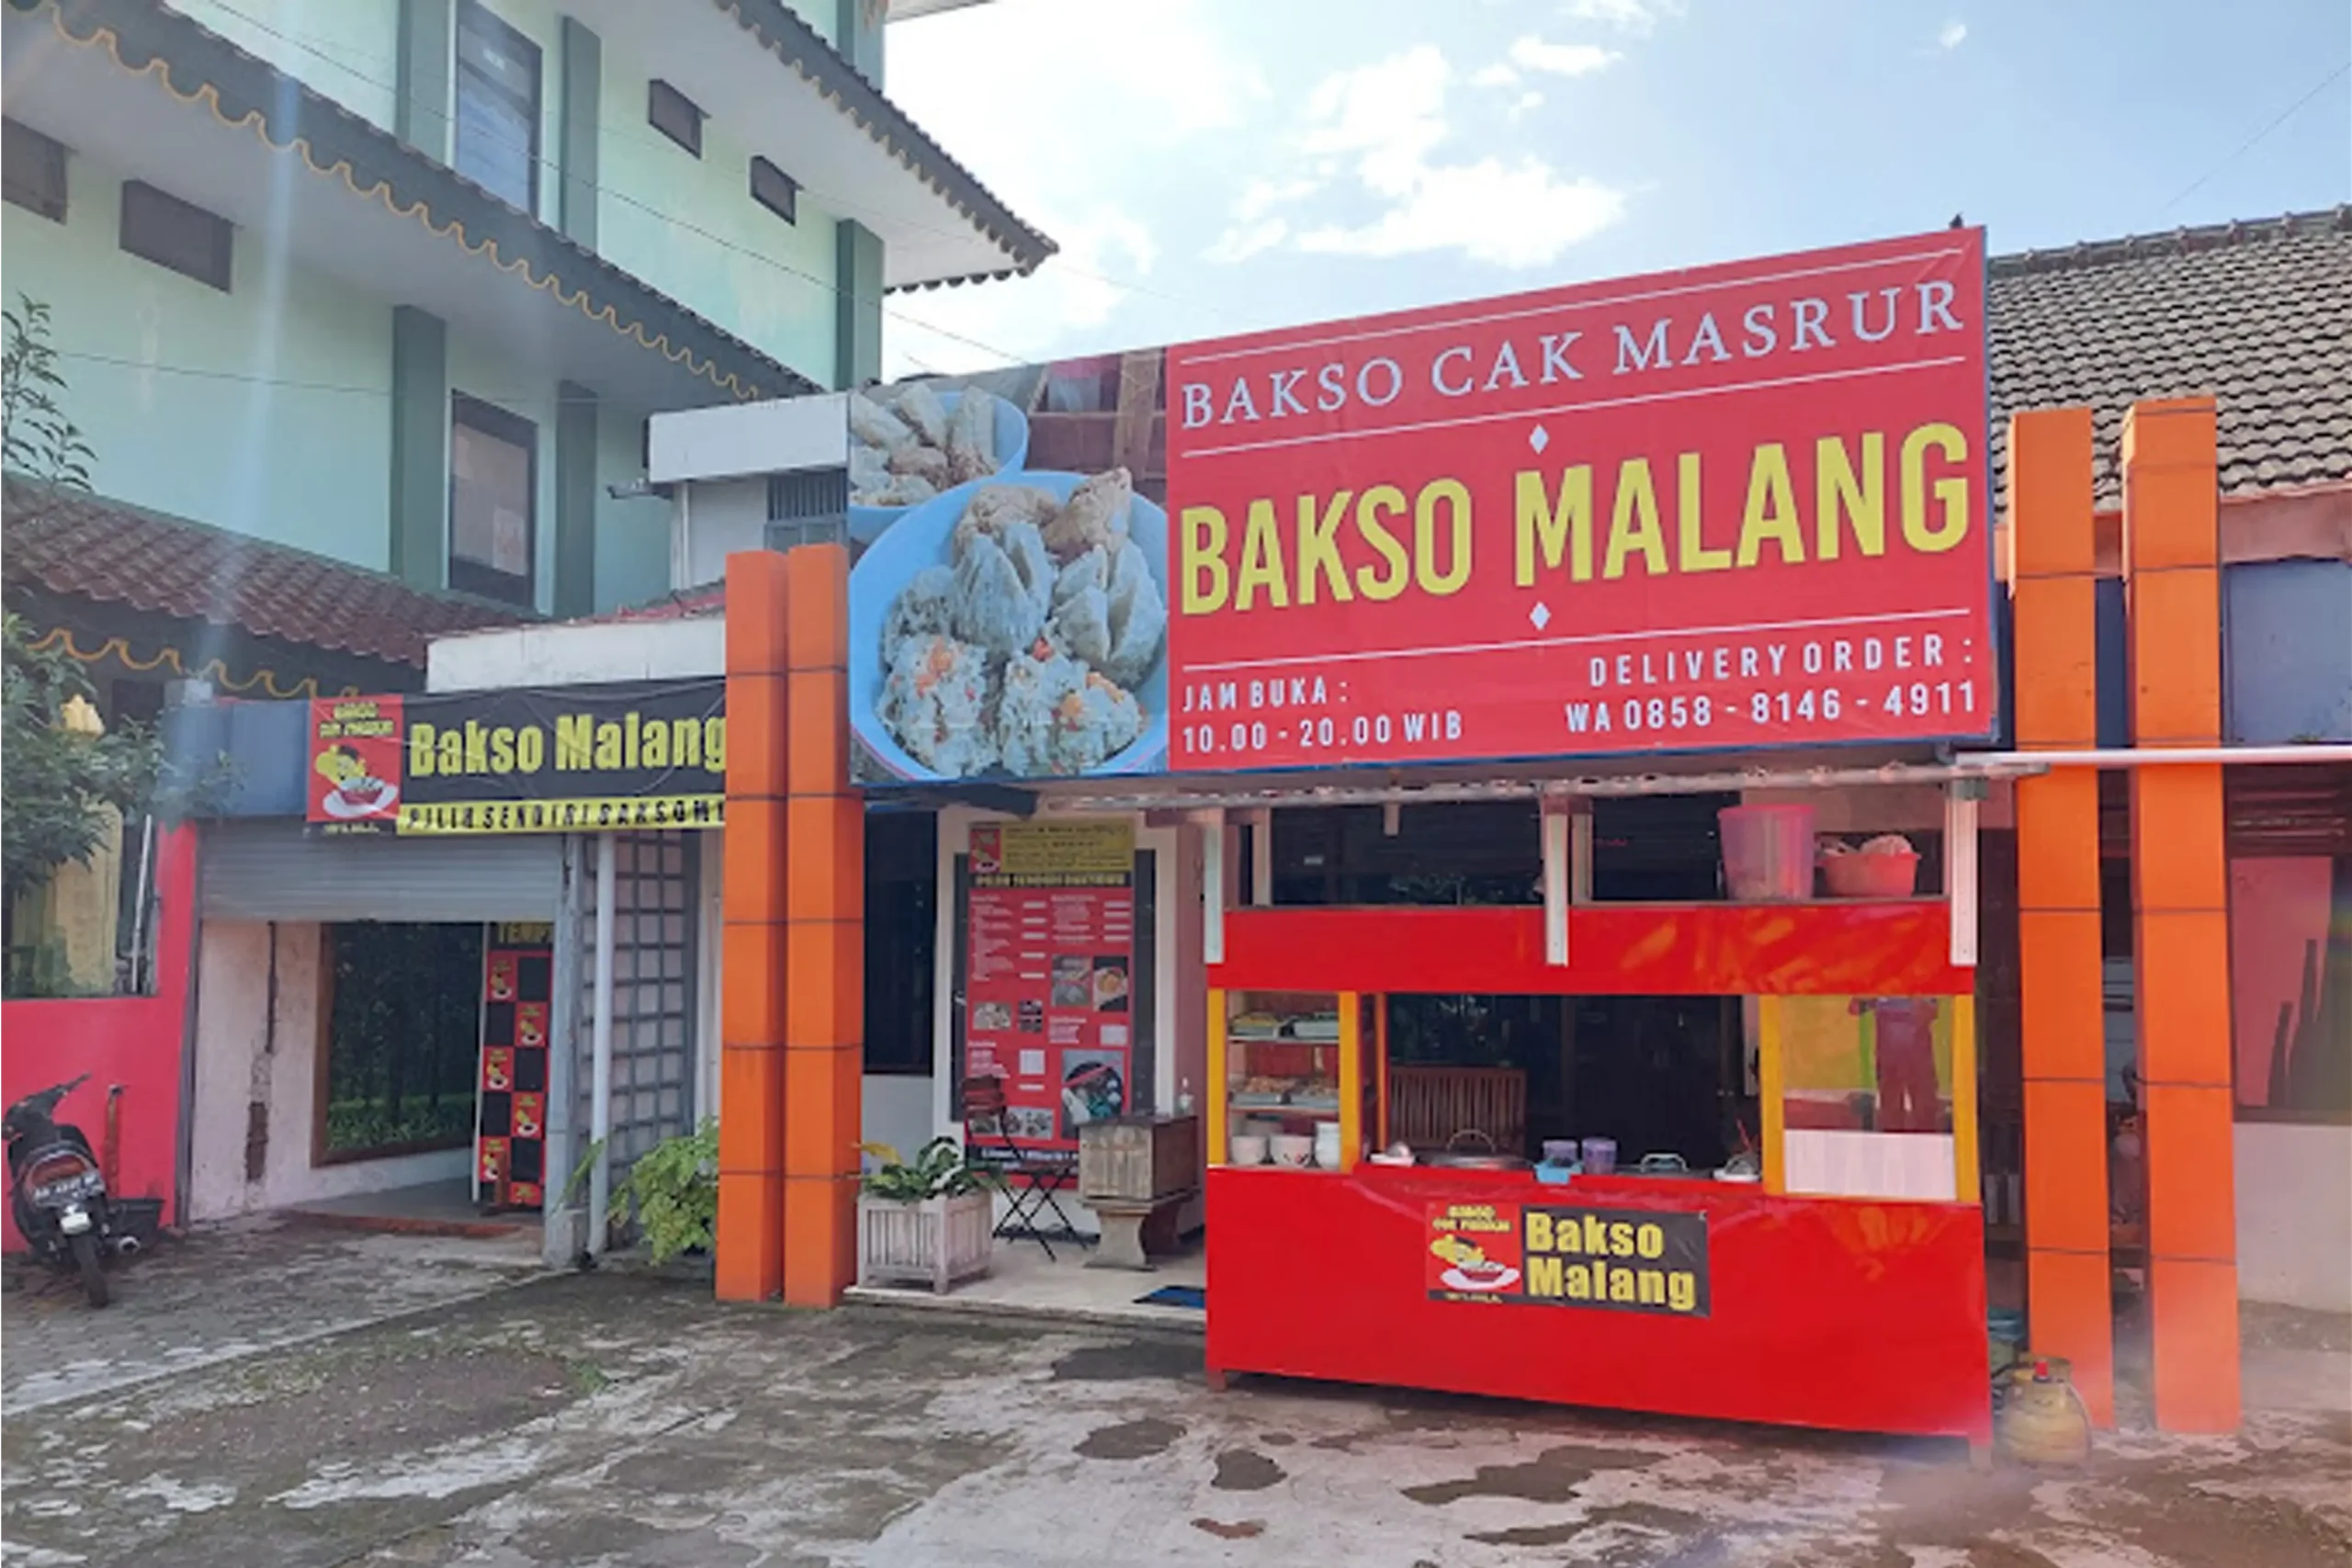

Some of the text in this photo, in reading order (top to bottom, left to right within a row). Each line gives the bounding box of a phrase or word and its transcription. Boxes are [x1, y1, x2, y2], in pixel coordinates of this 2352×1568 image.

[1182, 279, 1964, 430] BAKSO CAK MASRUR
[1180, 422, 1969, 615] BAKSO MALANG
[1589, 641, 1787, 688] DELIVERY
[1802, 634, 1944, 675] ORDER
[1182, 682, 1238, 713] JAM
[1249, 675, 1328, 709] BUKA
[1564, 701, 1612, 734] WA
[1623, 694, 1713, 731] 0858
[1750, 687, 1842, 725] 8146
[1882, 679, 1974, 717] 4911
[409, 711, 727, 777] Bakso Malang
[1182, 721, 1268, 753] 10.00
[1298, 715, 1392, 749] 20.00
[1402, 710, 1463, 742] WIB
[1525, 1211, 1665, 1259] Bakso
[1526, 1256, 1696, 1312] Malang
